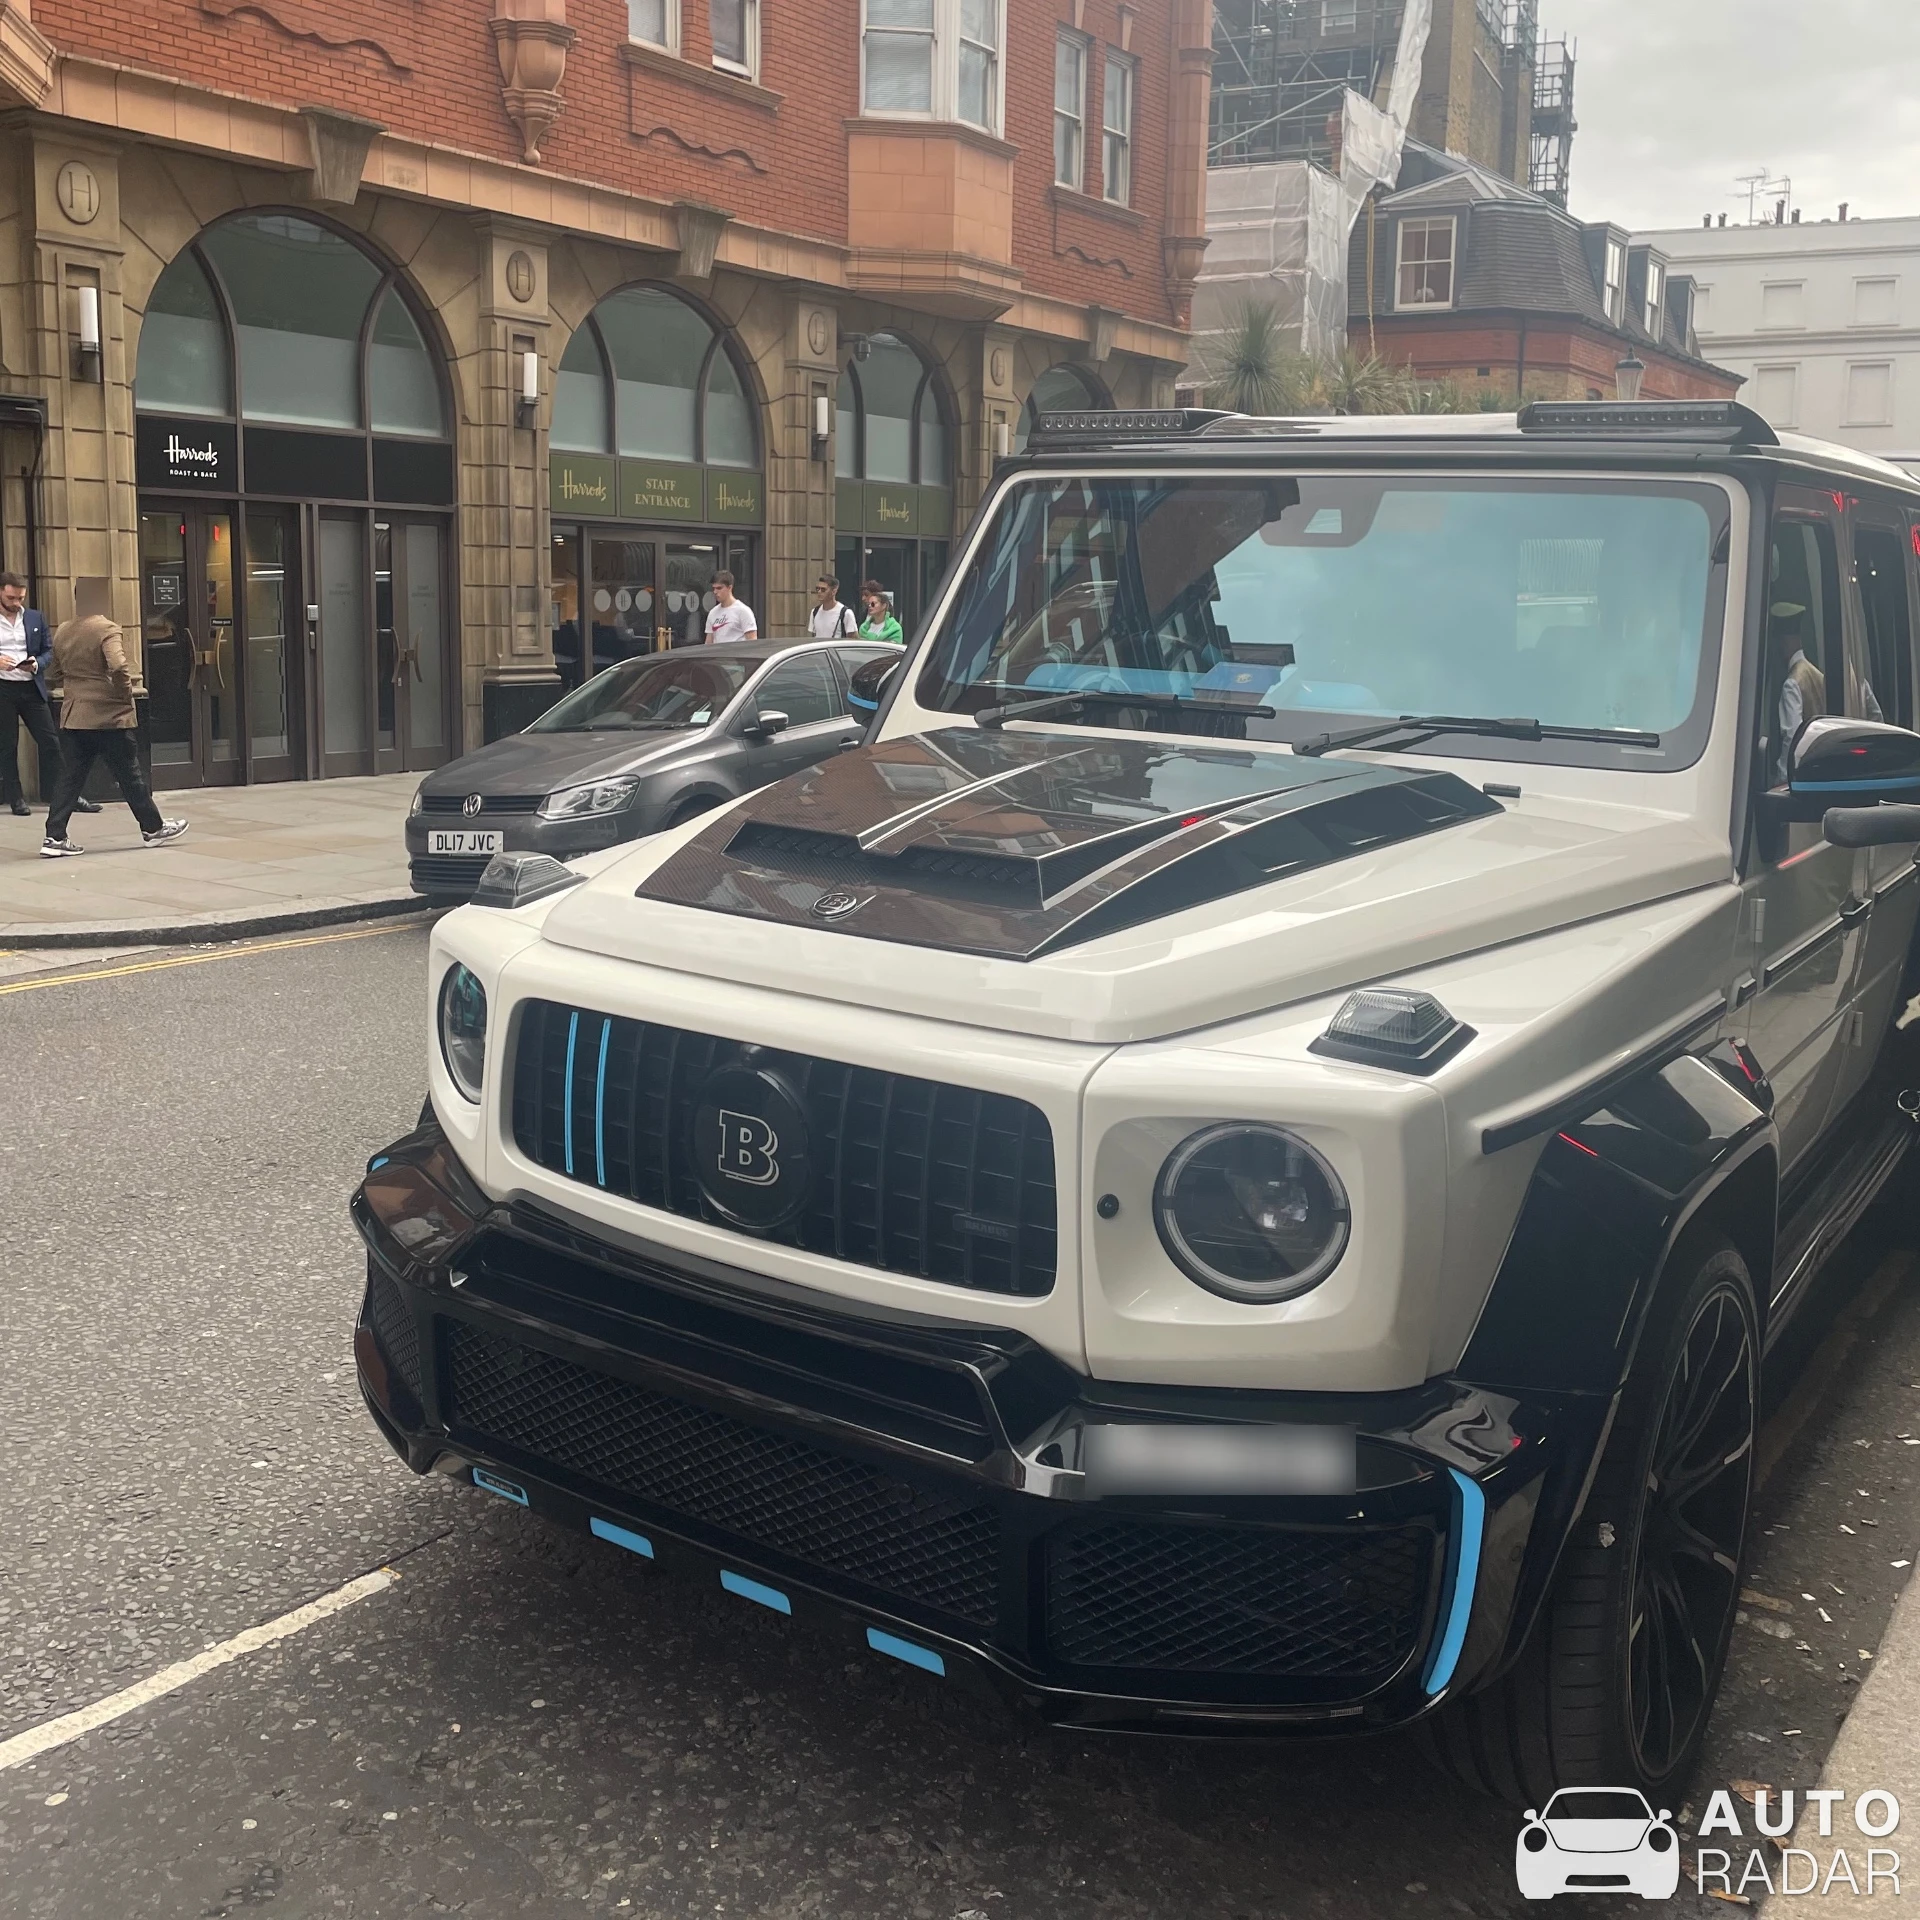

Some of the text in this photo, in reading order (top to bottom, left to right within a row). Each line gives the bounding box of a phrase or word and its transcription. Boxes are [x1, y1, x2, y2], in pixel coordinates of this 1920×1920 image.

[67, 170, 93, 214] H
[513, 259, 532, 292] H
[163, 434, 218, 467] Harrods
[169, 469, 192, 477] ROAST
[200, 471, 218, 479] BAKE
[559, 468, 607, 502] Harrods
[645, 478, 676, 491] STAFF
[634, 493, 691, 509] ENTRANCE
[714, 482, 755, 513] Harrods
[877, 496, 910, 523] Harrods
[436, 834, 495, 851] DL17 JVC
[718, 1108, 780, 1186] B
